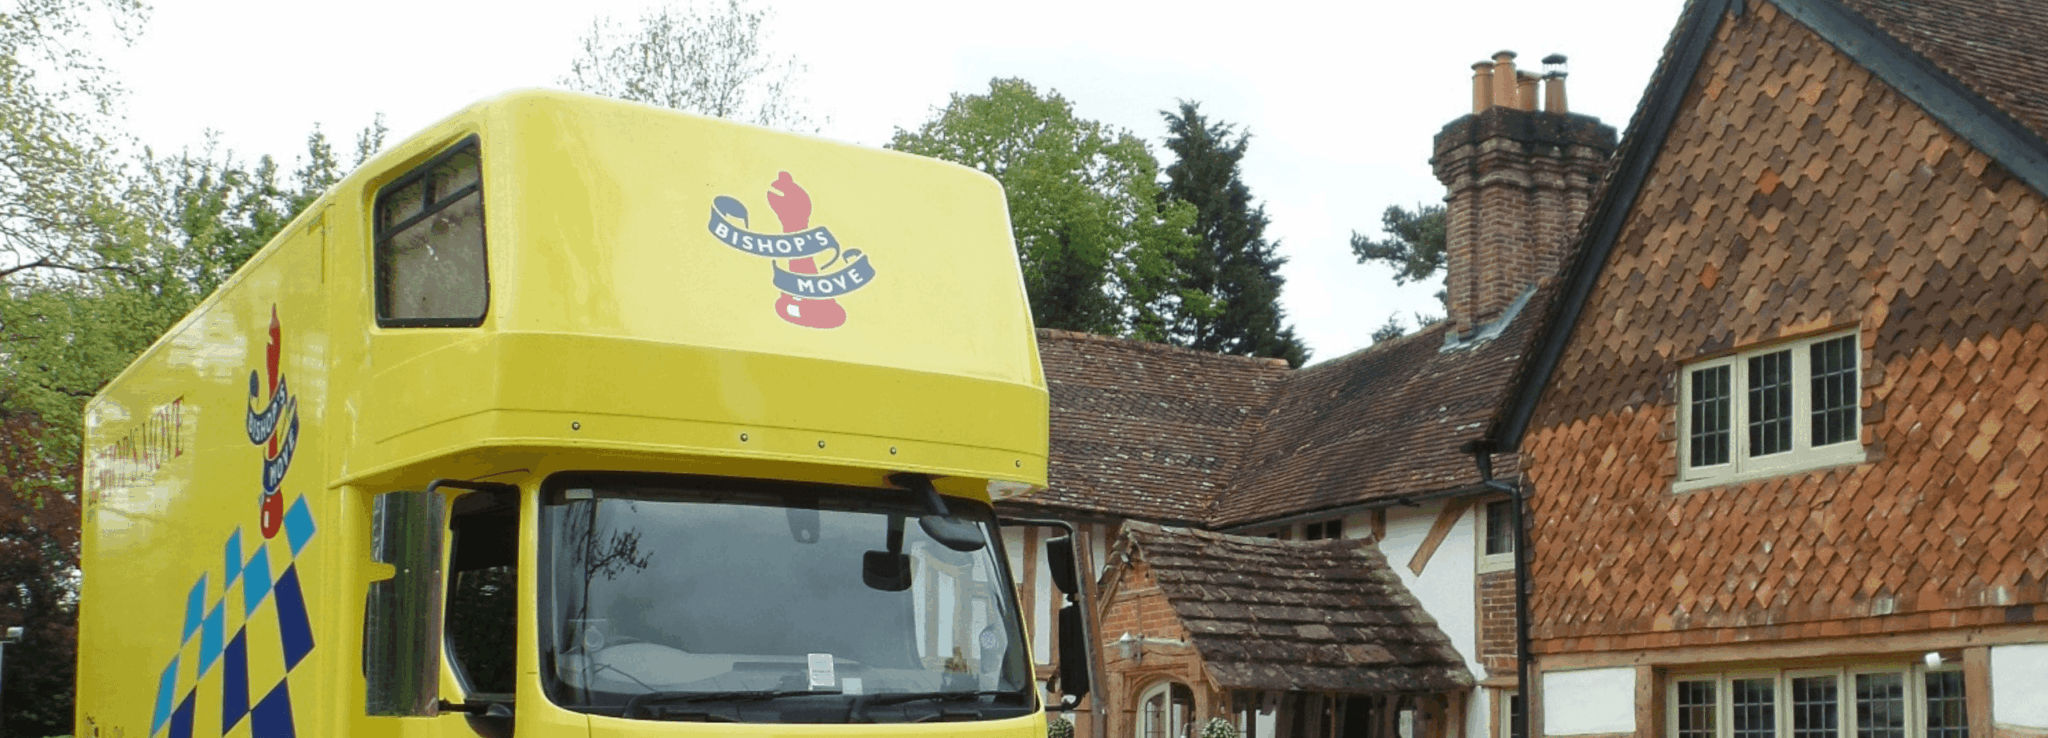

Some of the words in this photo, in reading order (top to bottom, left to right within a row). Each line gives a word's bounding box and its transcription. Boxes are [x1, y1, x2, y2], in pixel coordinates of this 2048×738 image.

[715, 222, 829, 254] BISHOP'S
[797, 268, 864, 294] MOVE
[248, 383, 286, 442] BISHOP'S
[269, 427, 295, 487] MOVE
